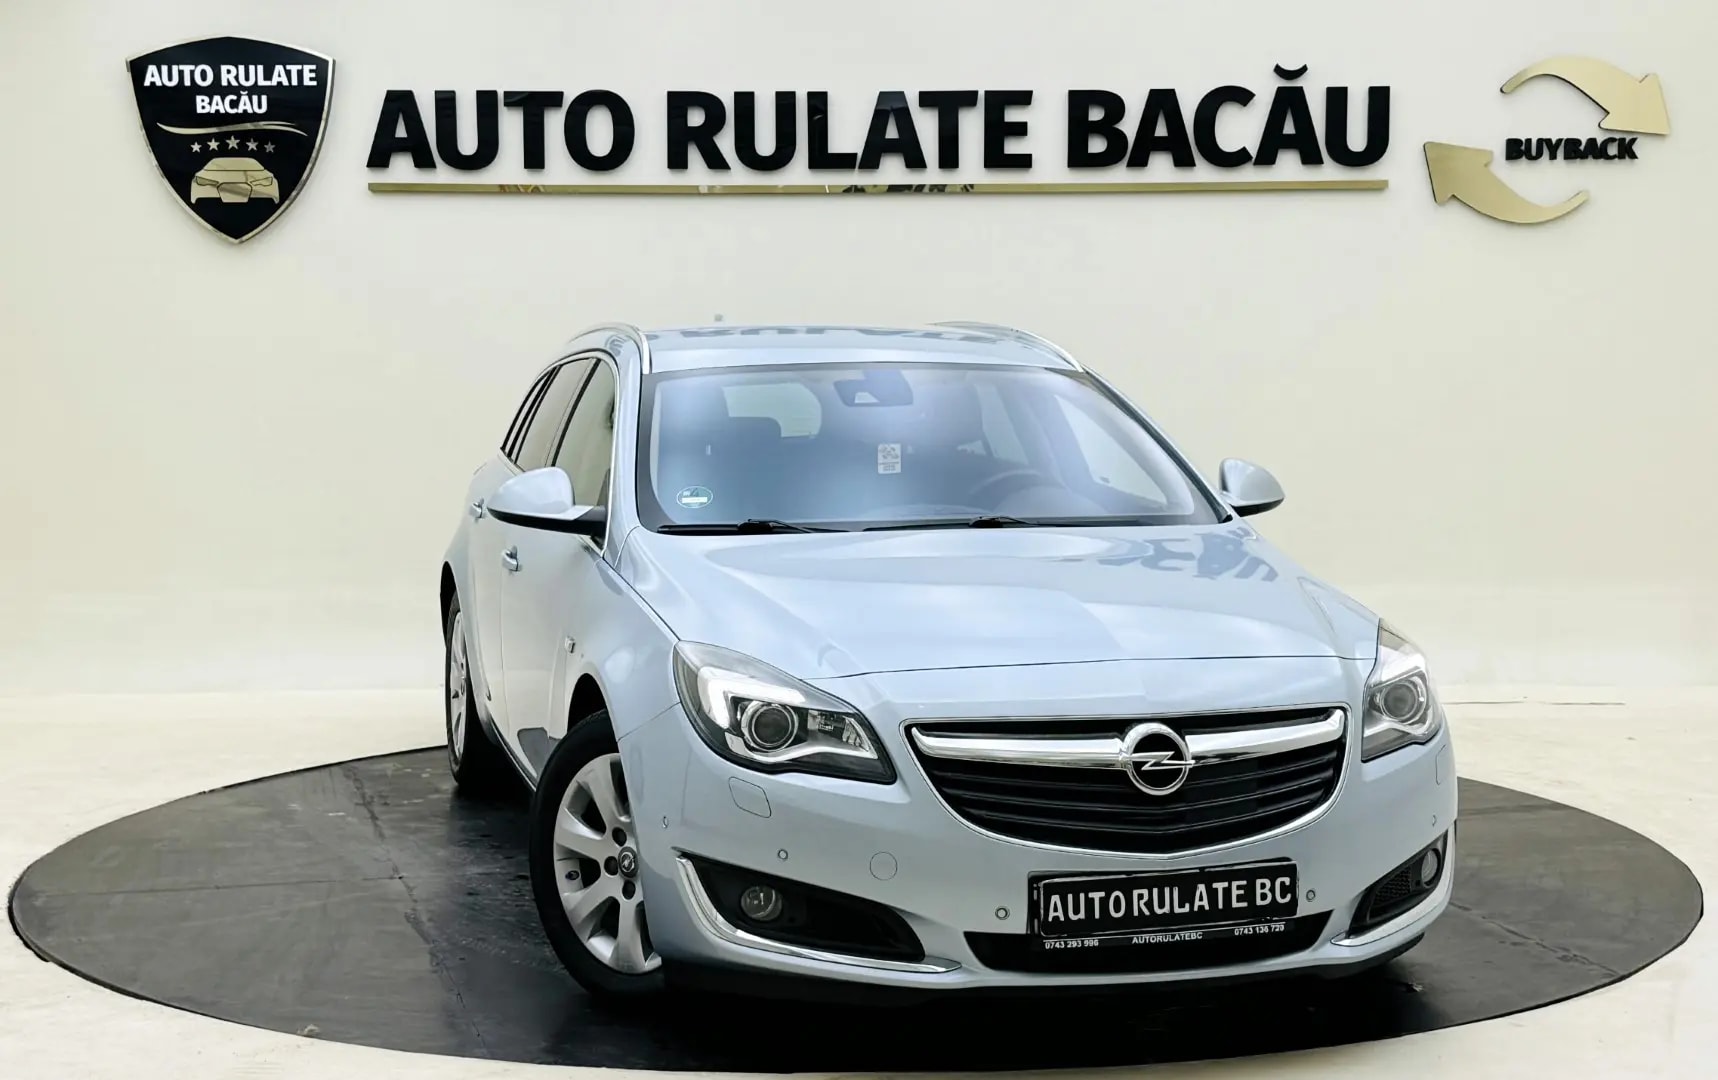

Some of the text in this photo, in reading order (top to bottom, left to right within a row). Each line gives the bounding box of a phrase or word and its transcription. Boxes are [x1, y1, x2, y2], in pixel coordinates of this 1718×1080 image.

[143, 64, 317, 87] AUTO RULATE
[195, 91, 268, 114] BACĂU
[366, 64, 1391, 172] AUTO RULATE BACĂU
[1505, 137, 1639, 161] BUYBACK
[1048, 876, 1292, 922] AUTO RULATE BC
[1131, 931, 1203, 944] AUTORULATEBC
[1234, 927, 1254, 935] 0743
[1045, 941, 1065, 949] 0743
